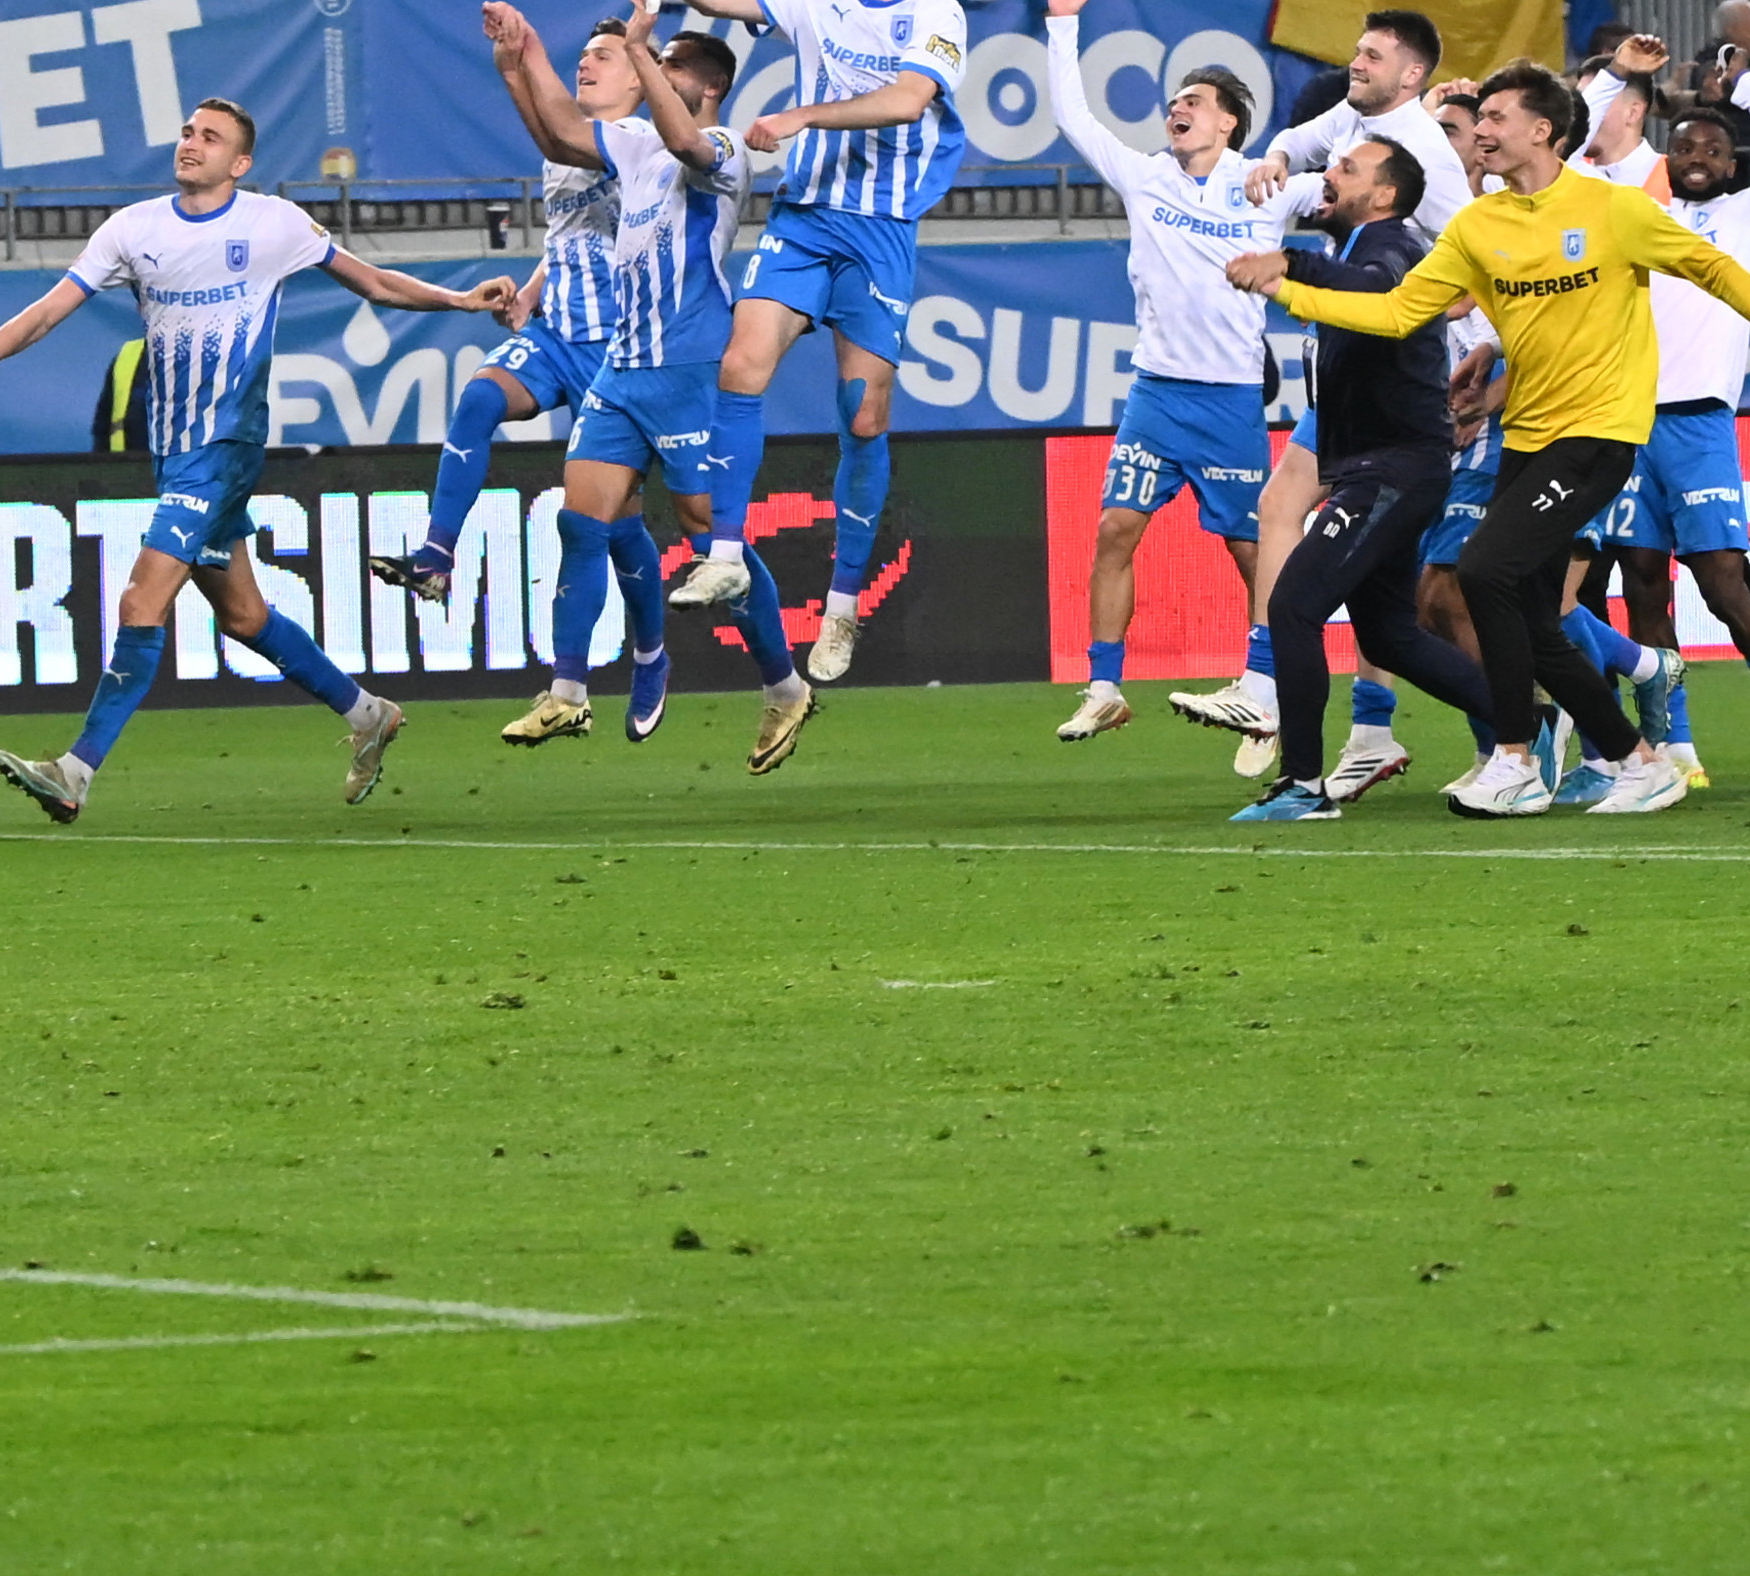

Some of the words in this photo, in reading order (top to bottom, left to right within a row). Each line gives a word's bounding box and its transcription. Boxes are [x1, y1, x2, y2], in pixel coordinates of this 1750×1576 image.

[822, 37, 902, 73] SUPERBE
[1151, 206, 1255, 240] SUPERBET
[145, 280, 248, 308] SUPERBET
[1494, 266, 1600, 298] SUPERBET
[484, 341, 529, 370] 29
